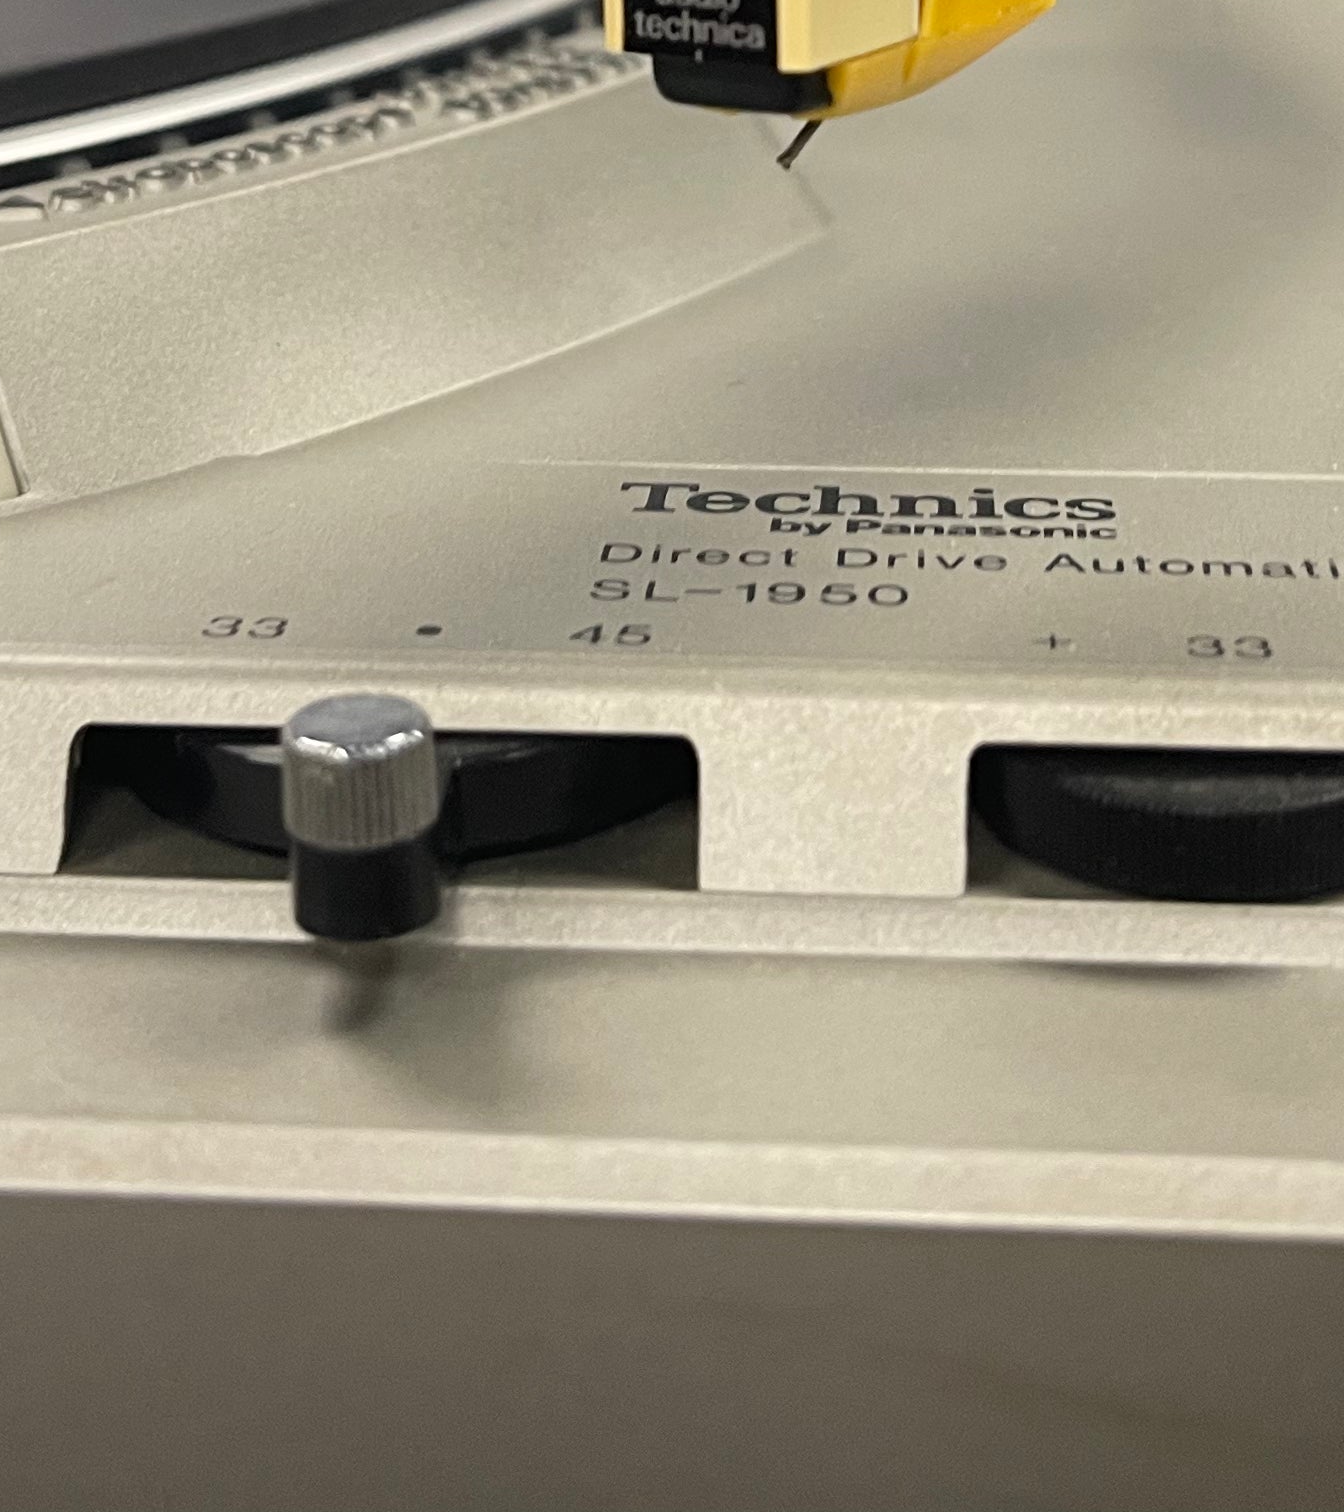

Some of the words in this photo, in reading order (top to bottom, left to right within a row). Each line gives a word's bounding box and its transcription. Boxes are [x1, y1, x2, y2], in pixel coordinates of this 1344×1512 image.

[633, 8, 766, 51] technica
[620, 482, 1117, 521] Technics
[769, 518, 832, 537] by
[844, 519, 1117, 540] Panasonic
[600, 543, 798, 568] Direct
[836, 548, 1008, 572] Drive
[589, 578, 909, 607] SL-1950
[201, 615, 289, 639] 33
[568, 623, 652, 647] 45
[1187, 635, 1272, 659] 33
